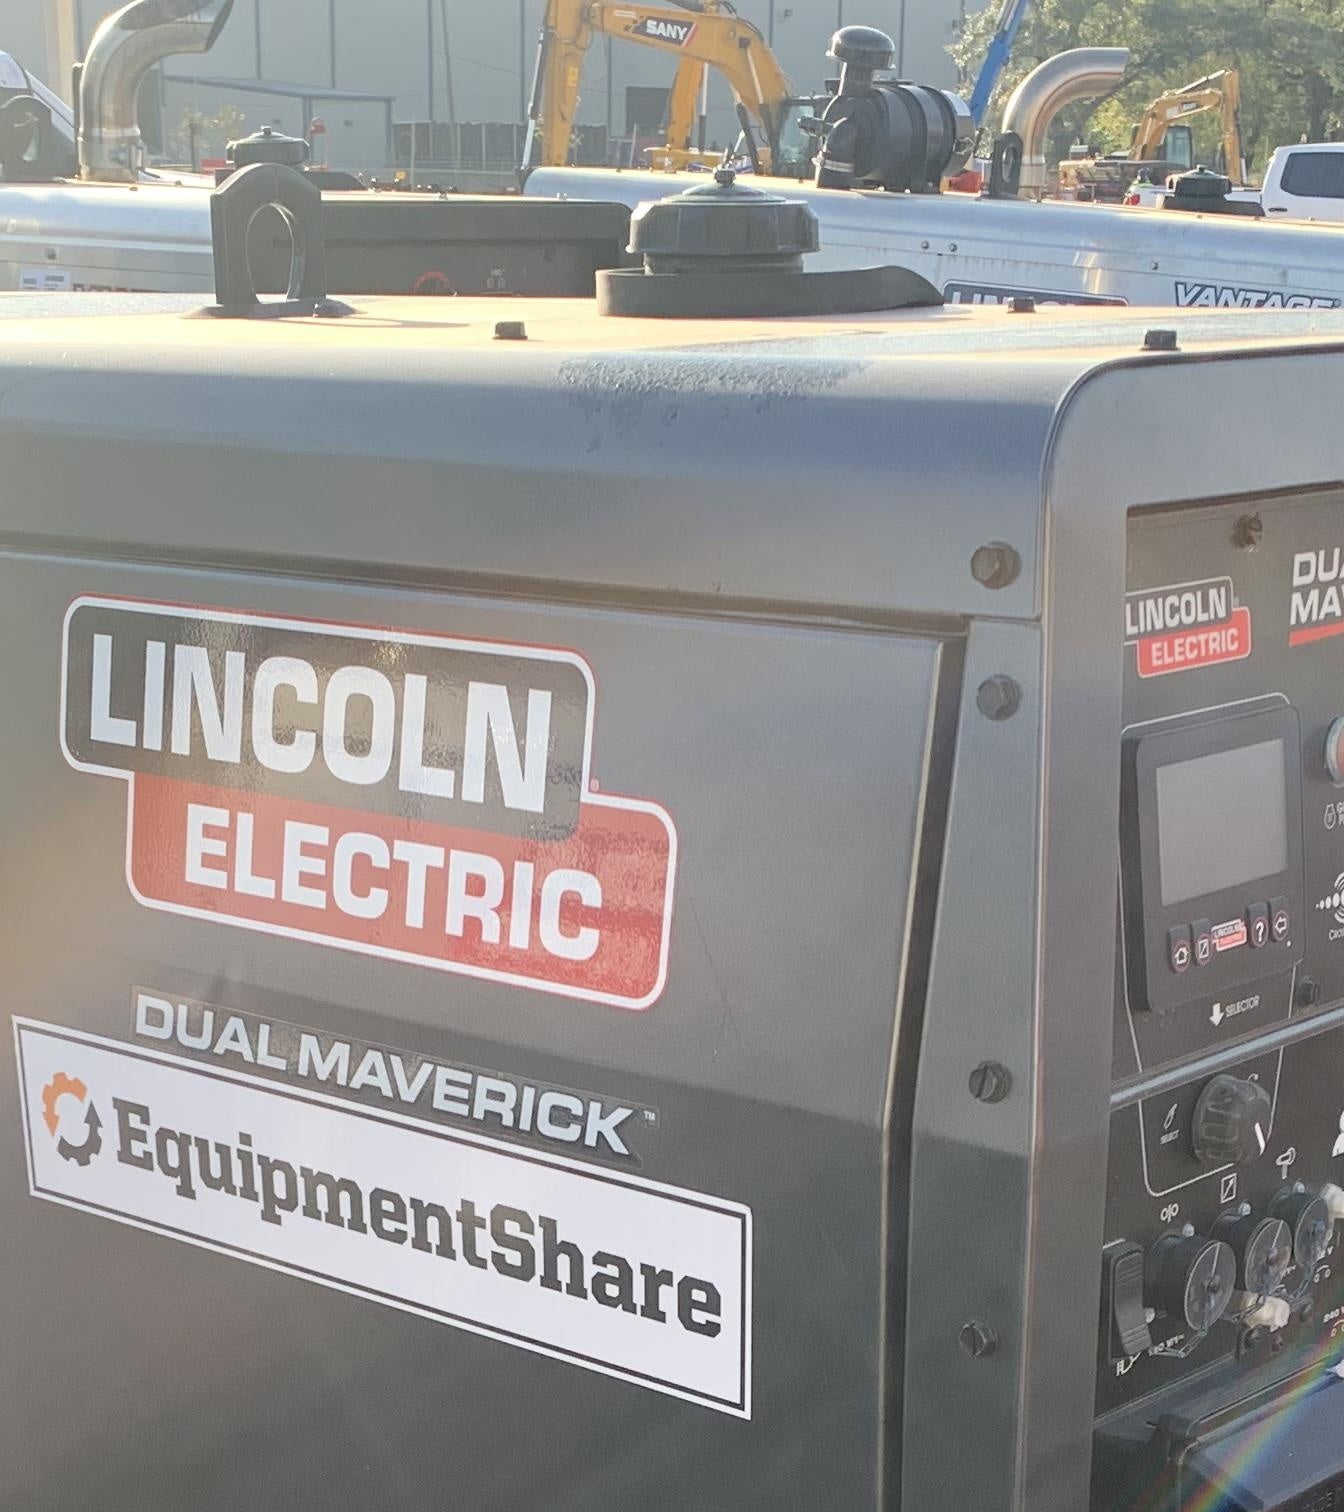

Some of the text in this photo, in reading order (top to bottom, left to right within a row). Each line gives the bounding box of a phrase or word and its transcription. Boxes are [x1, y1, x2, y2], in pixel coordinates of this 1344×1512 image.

[645, 19, 688, 40] SANY
[1124, 586, 1227, 636] LINCOLN
[1151, 628, 1240, 667] ELECTRIC
[88, 632, 554, 815] LINCOLN
[183, 802, 603, 961] ELECTRIC
[1225, 994, 1260, 1018] SELECTOR
[134, 992, 636, 1157] DUAL MAVERICK
[111, 1095, 722, 1339] EquipmentShare
